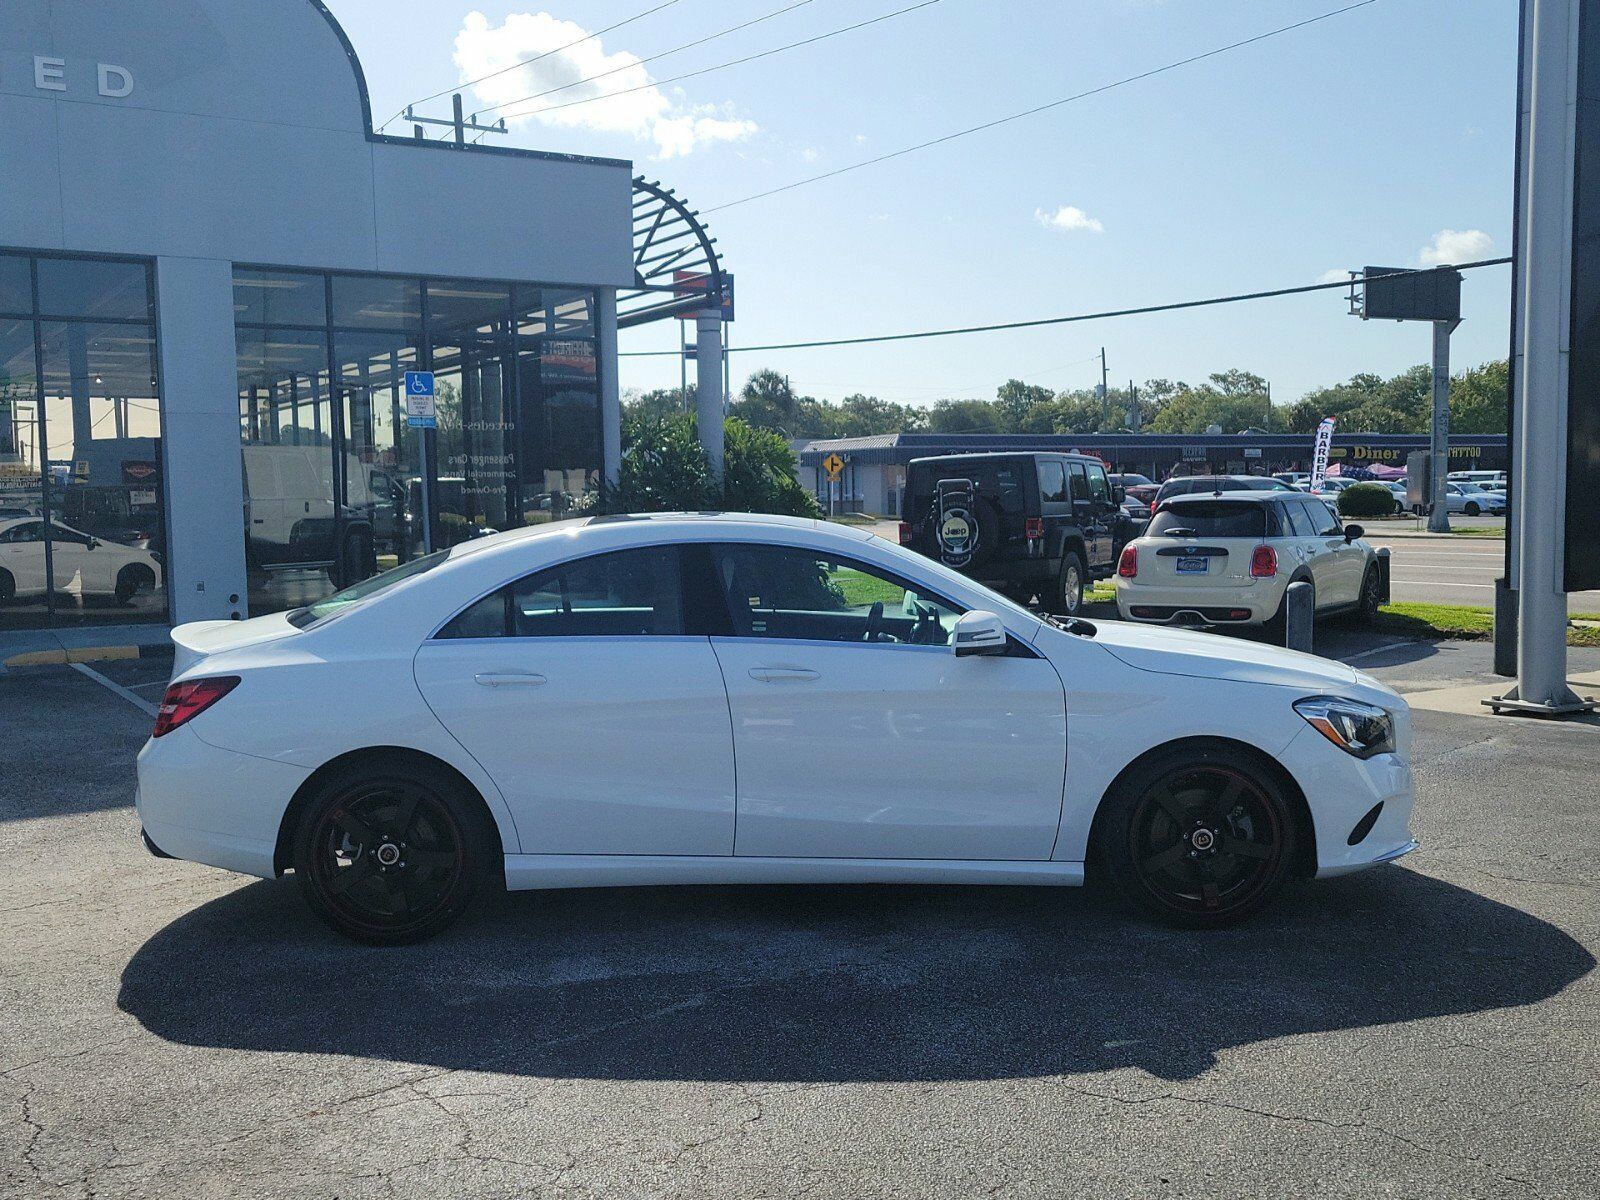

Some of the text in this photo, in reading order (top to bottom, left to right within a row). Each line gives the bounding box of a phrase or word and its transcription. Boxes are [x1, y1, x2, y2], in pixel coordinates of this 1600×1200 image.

[1315, 431, 1329, 481] BARBER
[1353, 446, 1401, 460] Diner
[1447, 446, 1481, 458] TATTOO
[945, 527, 966, 536] Jeep
